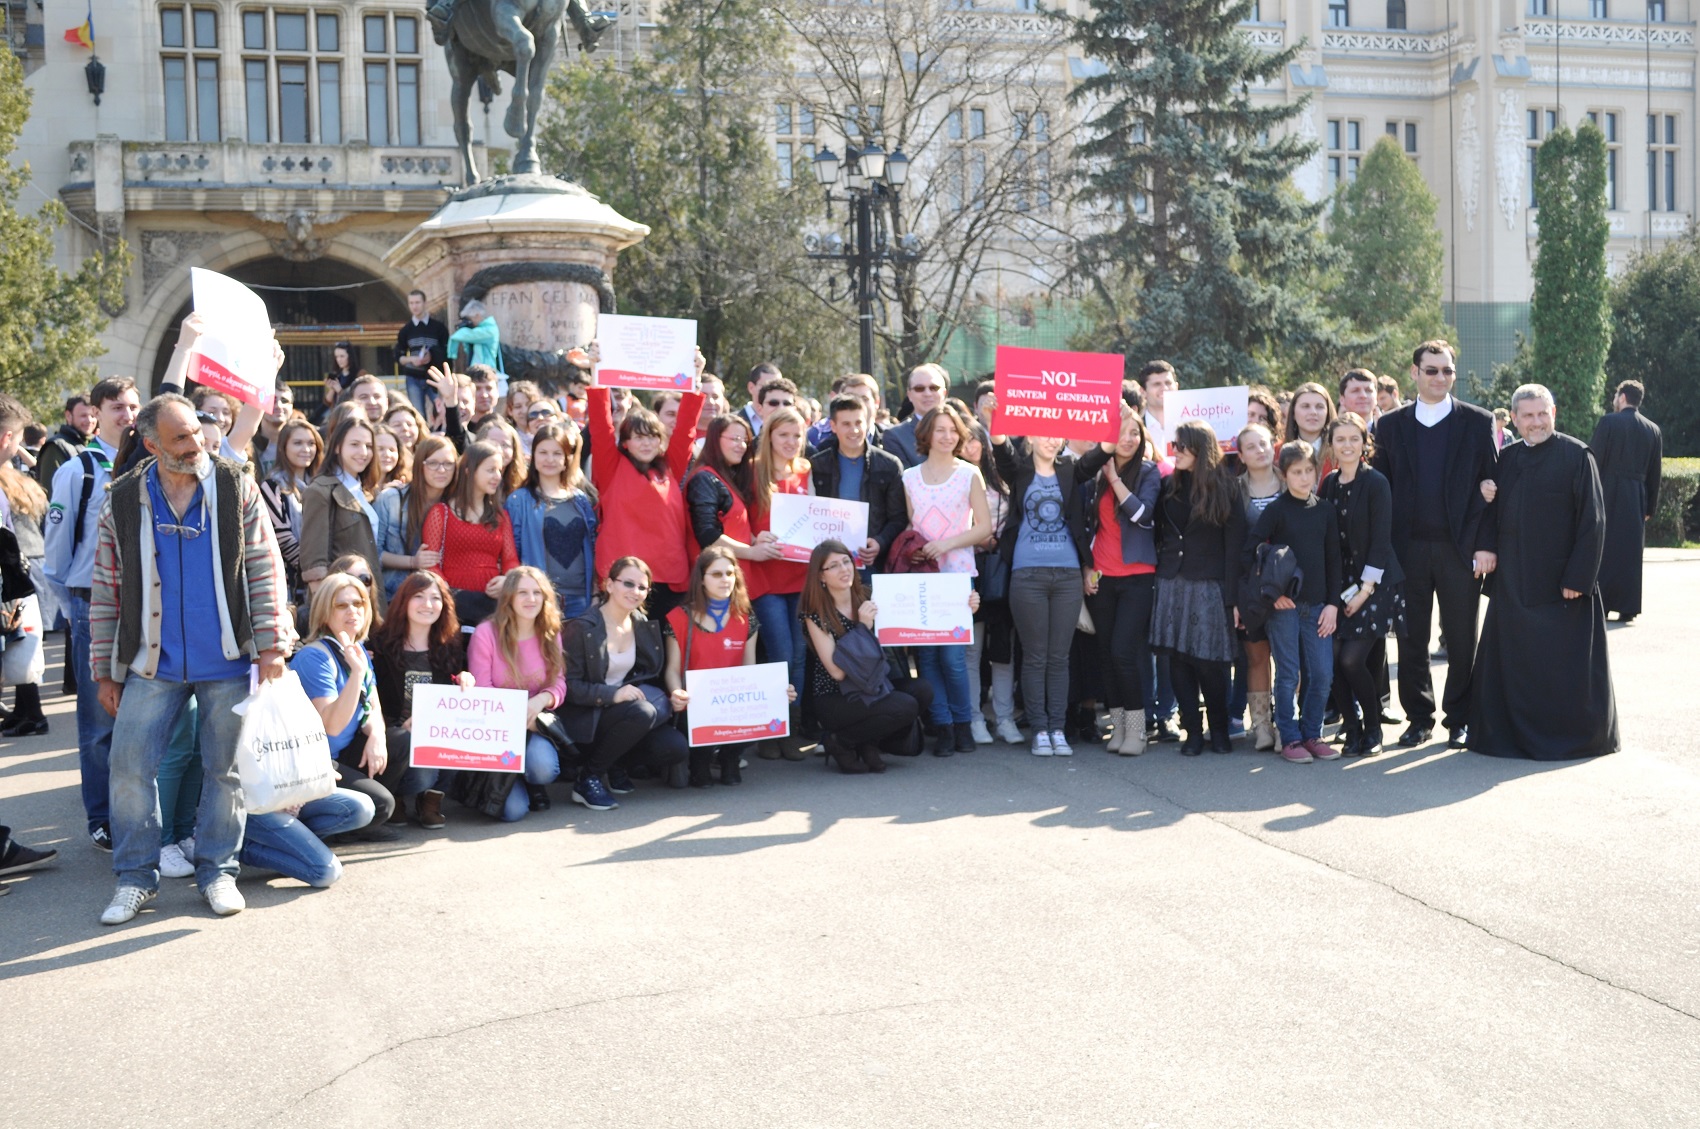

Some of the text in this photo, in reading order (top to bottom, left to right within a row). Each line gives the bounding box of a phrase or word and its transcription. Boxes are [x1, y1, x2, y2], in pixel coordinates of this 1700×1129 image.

[542, 290, 570, 304] CEL
[1041, 370, 1077, 387] NOI
[1006, 389, 1110, 405] SUNTEM GENERAȚIA
[1005, 405, 1109, 425] PENTRU VIAȚĂ
[1181, 402, 1234, 419] Adopție,
[808, 502, 851, 520] femeie
[813, 520, 844, 534] copil
[919, 581, 928, 626] AVORTUL
[437, 698, 504, 715] ADOPȚIA
[711, 690, 768, 706] AVORTUL
[430, 726, 509, 742] DRAGOSTE
